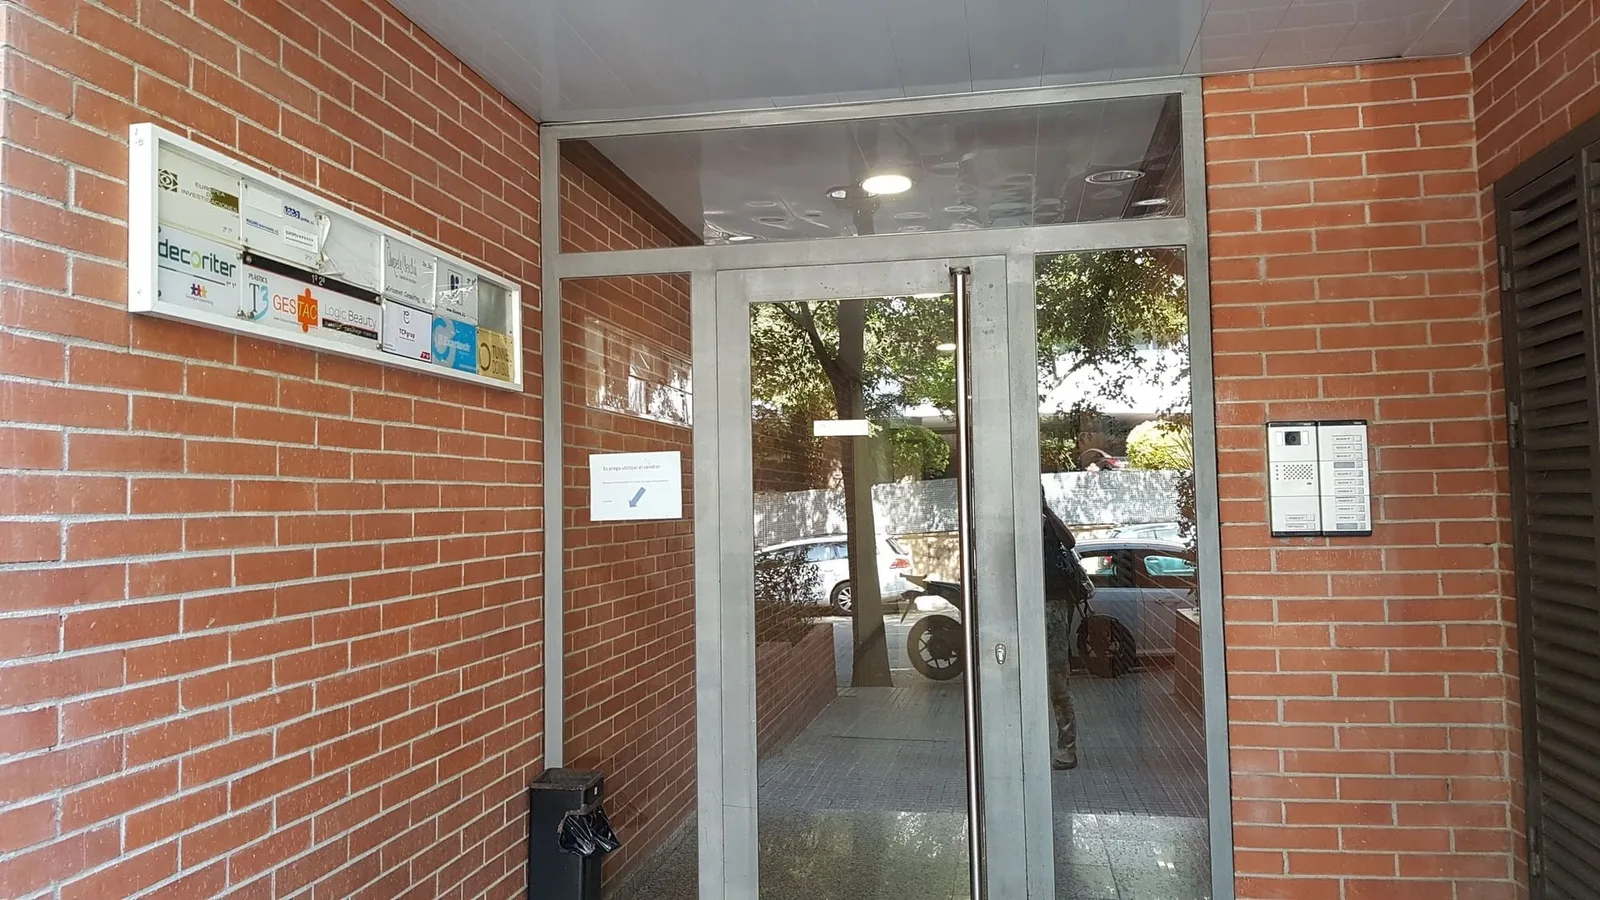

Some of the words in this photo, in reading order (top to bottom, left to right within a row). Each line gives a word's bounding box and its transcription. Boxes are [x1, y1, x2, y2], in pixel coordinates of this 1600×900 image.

[158, 239, 237, 278] decoriter
[248, 272, 268, 284] PLASTICS
[249, 283, 269, 320] T3
[324, 303, 347, 322] Logic
[348, 309, 377, 330] Beauty
